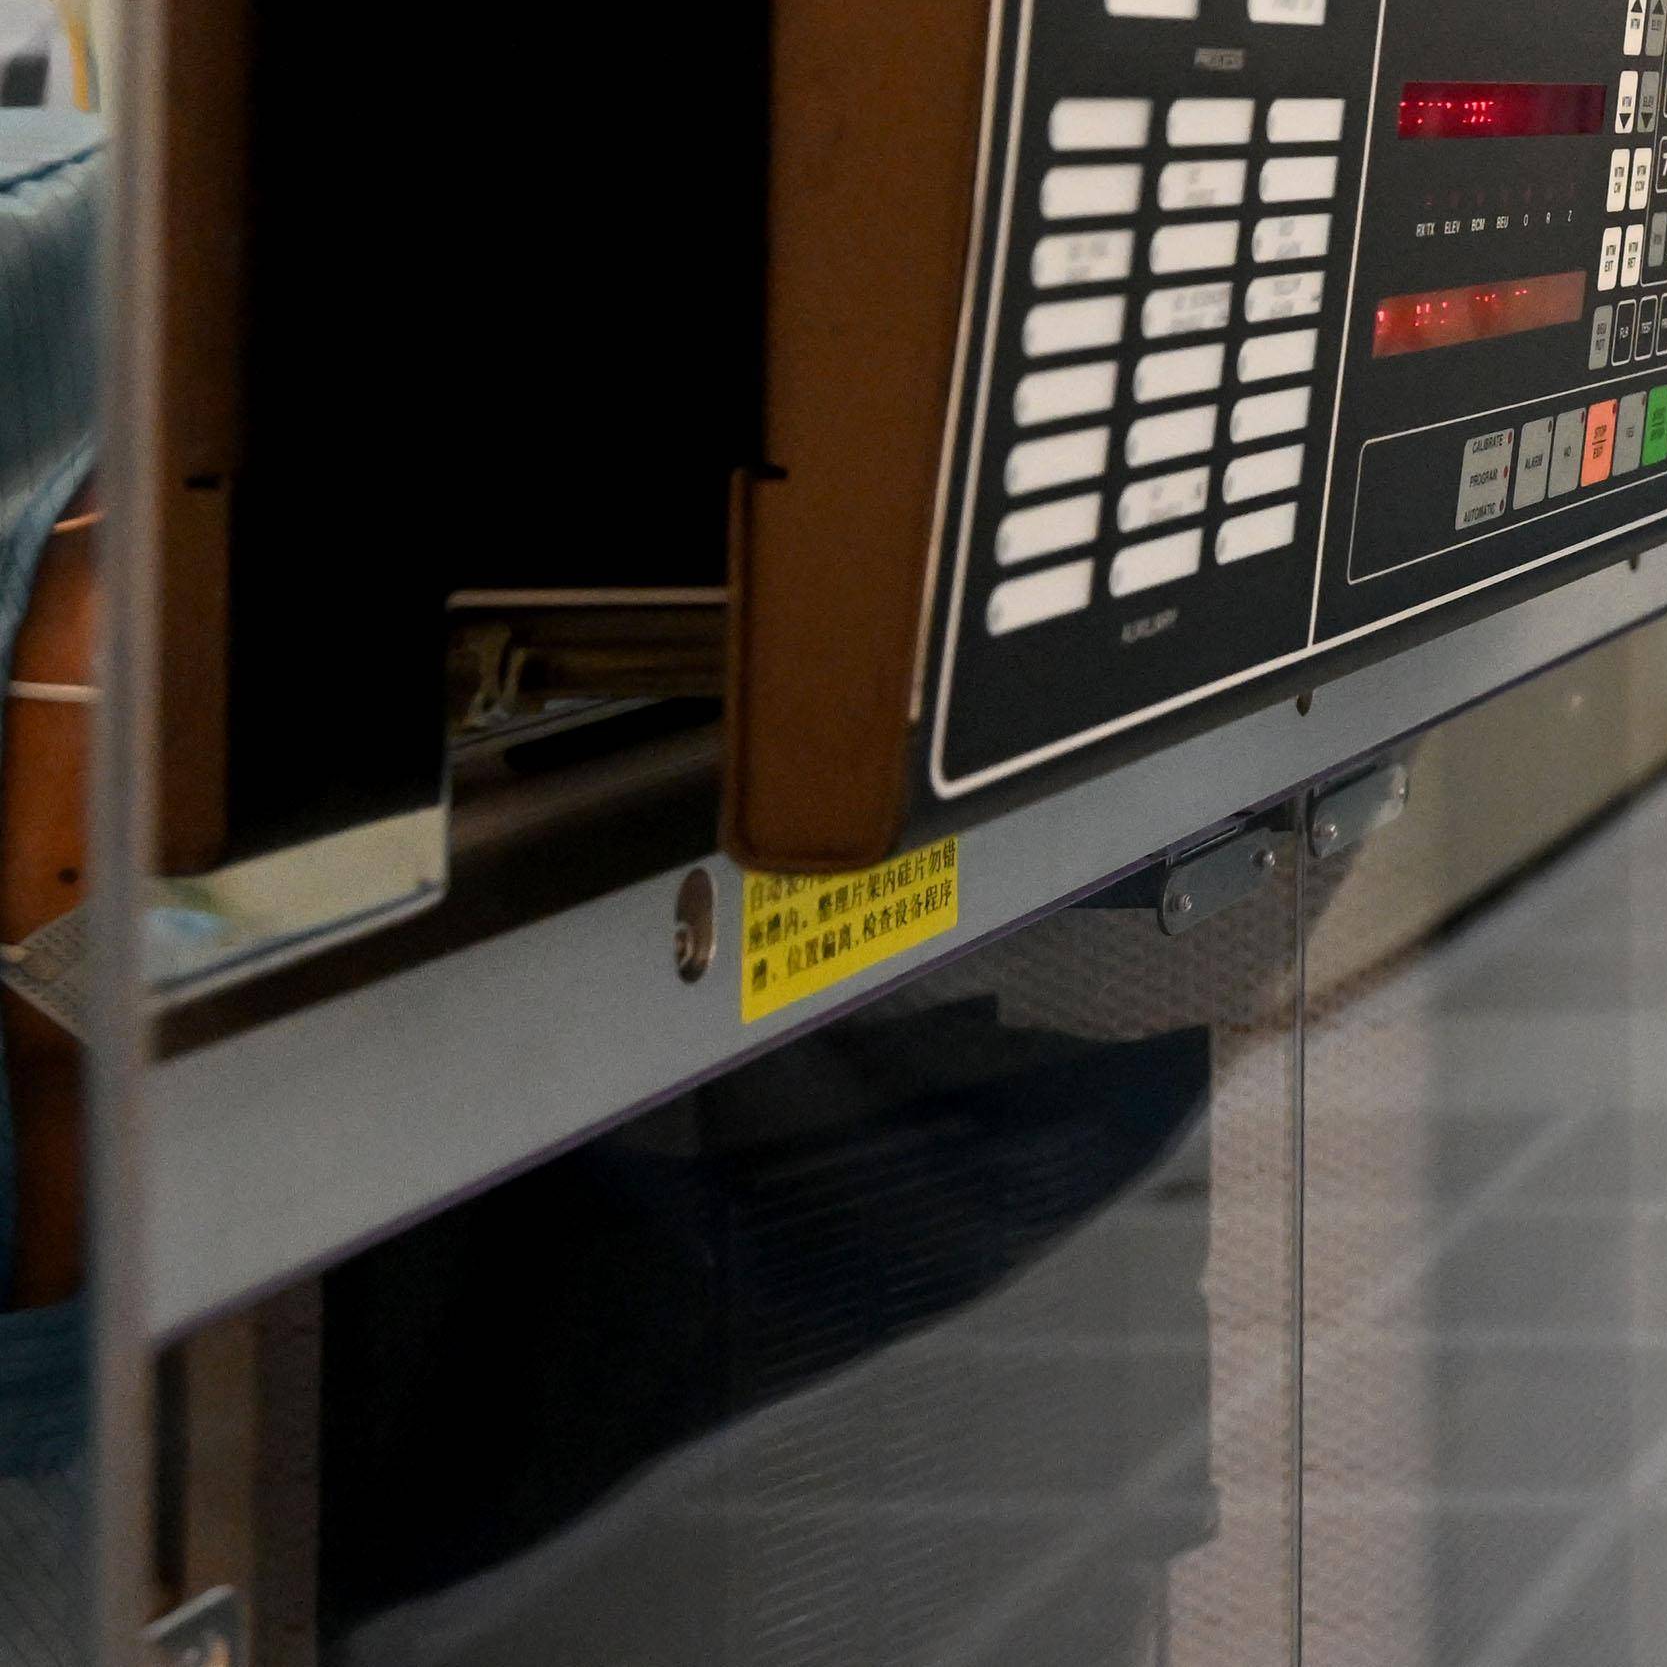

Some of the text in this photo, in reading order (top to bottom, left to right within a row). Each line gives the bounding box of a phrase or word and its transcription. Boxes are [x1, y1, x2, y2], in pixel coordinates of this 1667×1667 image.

[1444, 220, 1461, 235] ELEV
[1472, 433, 1504, 454] CALIBRATE
[1524, 453, 1544, 470] ALARM
[1469, 468, 1498, 488] PROGRAM
[1463, 502, 1497, 523] AUTOMATIC
